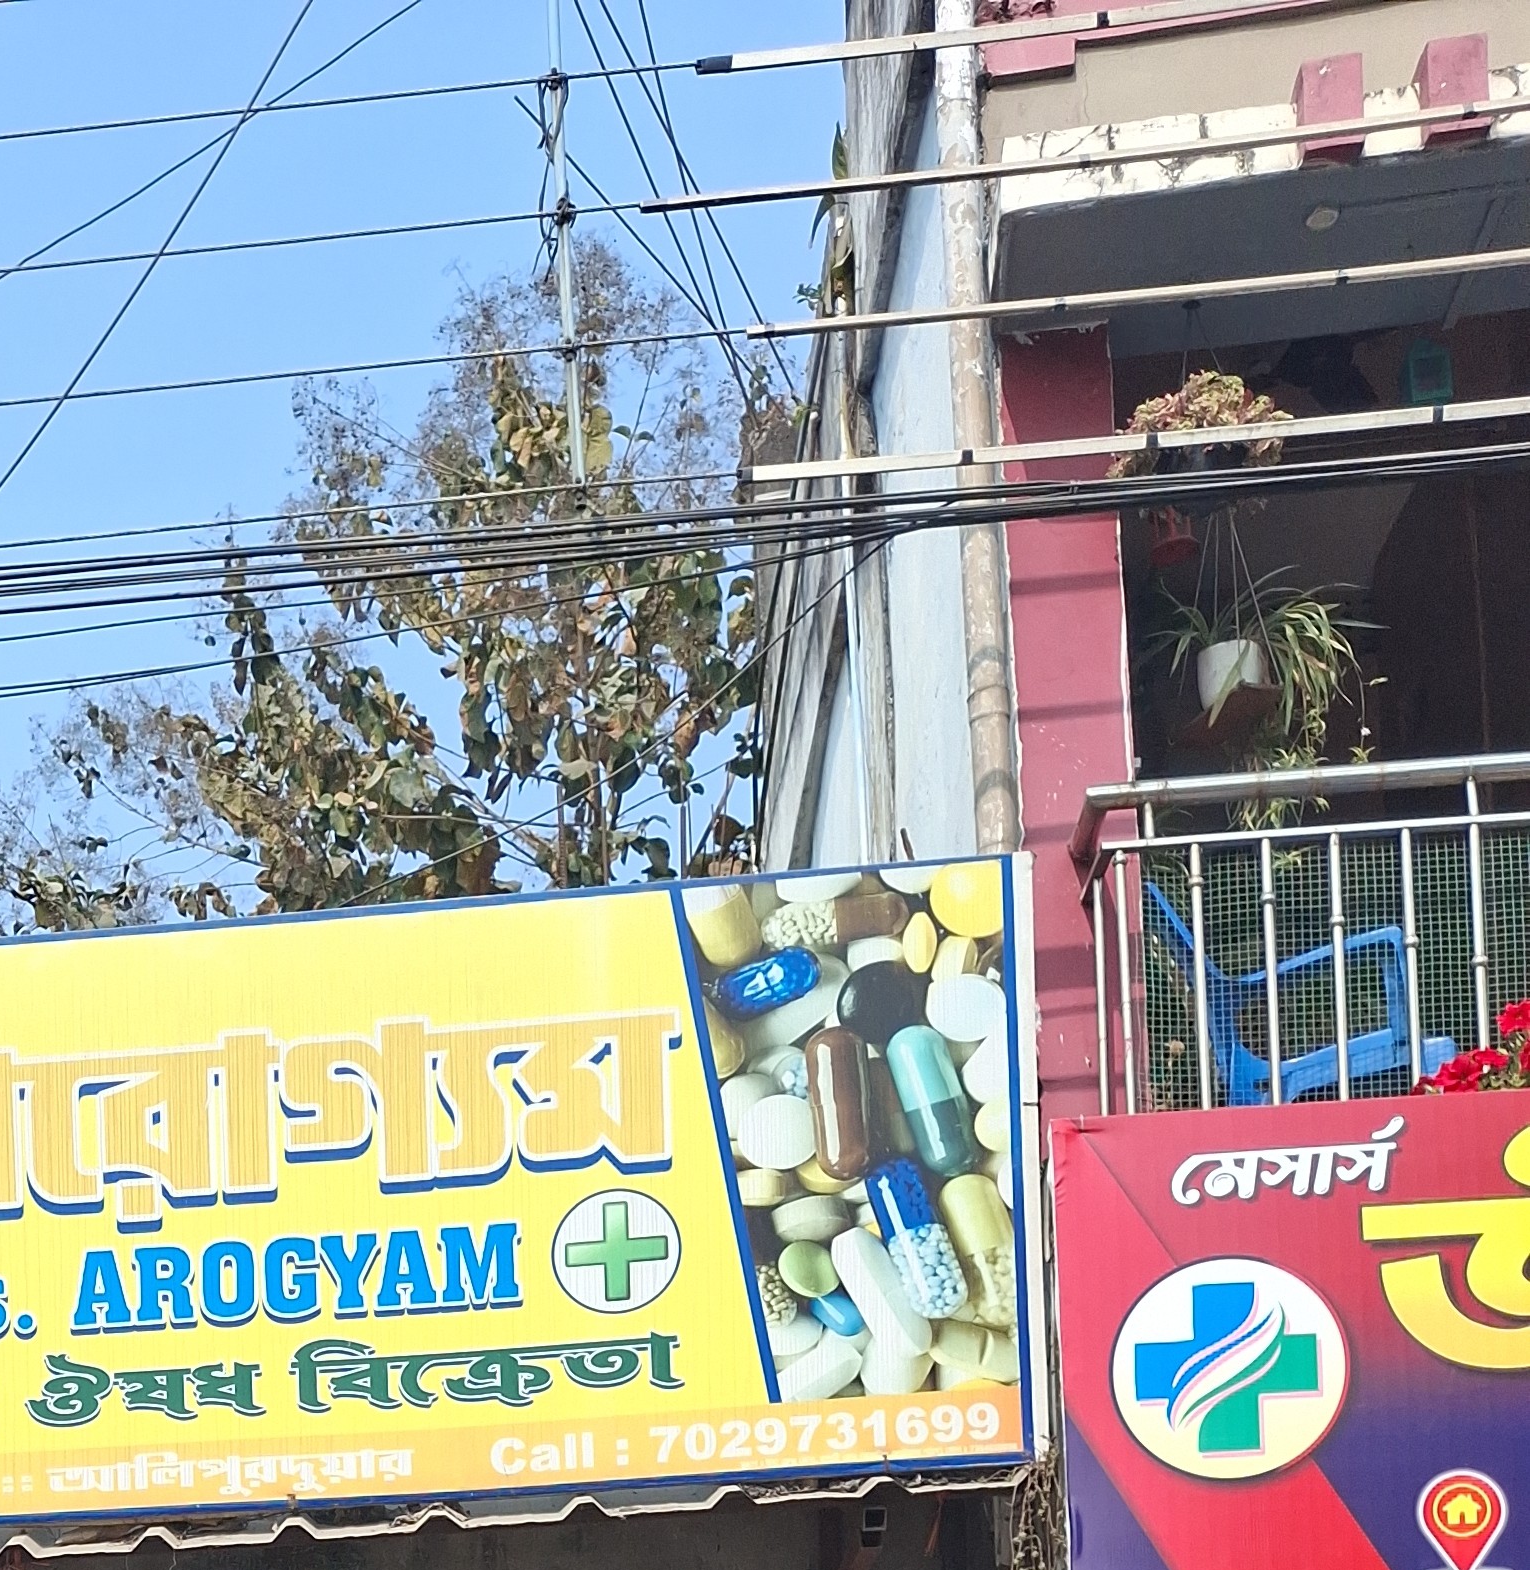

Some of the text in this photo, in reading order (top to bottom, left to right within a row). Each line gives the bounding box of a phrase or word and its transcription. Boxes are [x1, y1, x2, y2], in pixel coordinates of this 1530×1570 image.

[1170, 1114, 1407, 1207] মেসার্স
[71, 1221, 523, 1337] AROGYAM
[25, 1353, 265, 1426] ঔষধ
[291, 1331, 686, 1414] বিক্রেতা
[489, 1432, 596, 1477] Call
[648, 1403, 1001, 1464] 7029731699
